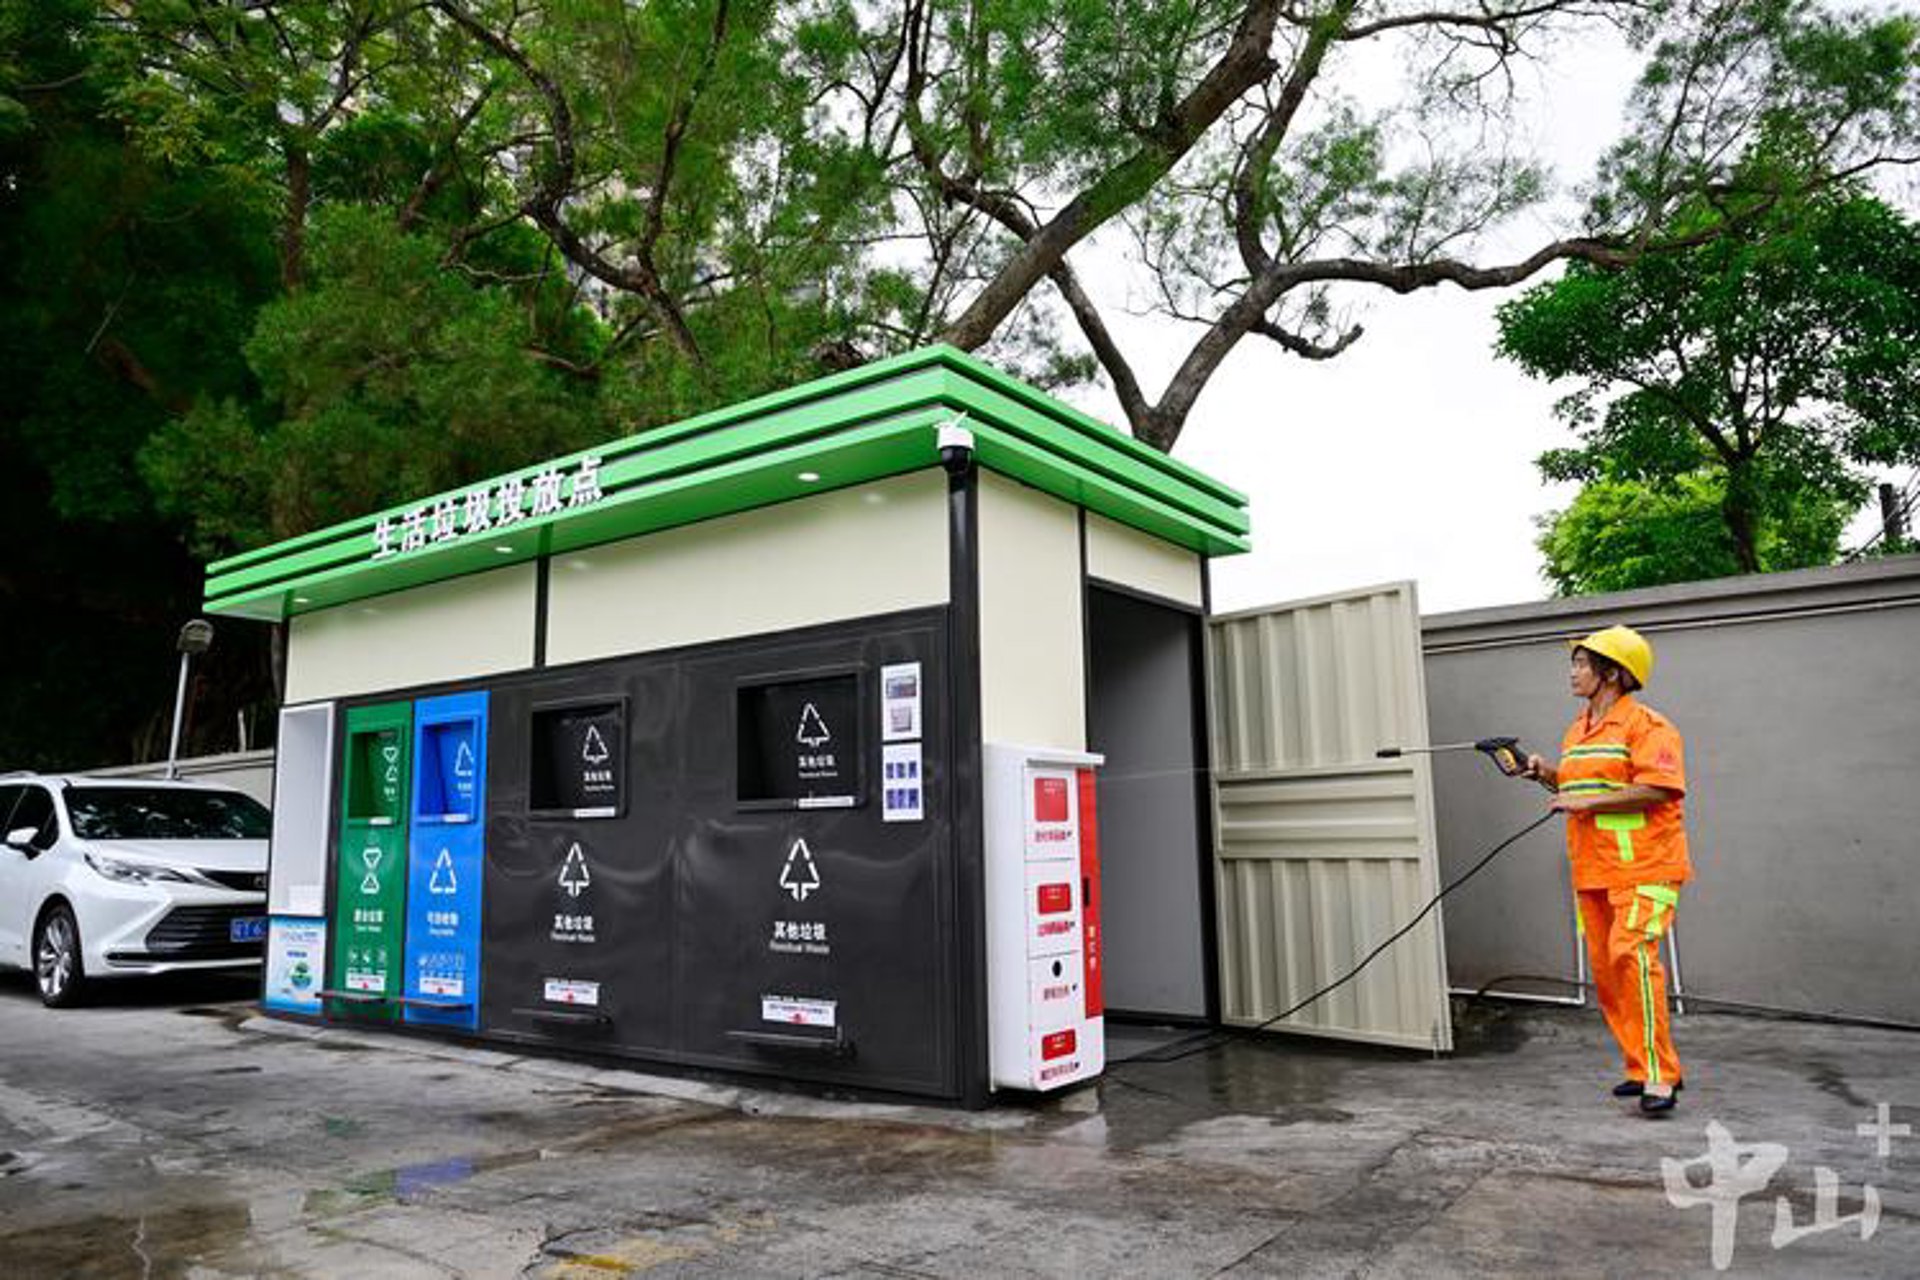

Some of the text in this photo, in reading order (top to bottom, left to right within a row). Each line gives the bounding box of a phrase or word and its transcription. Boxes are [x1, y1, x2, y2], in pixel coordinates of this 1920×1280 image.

[372, 455, 603, 559] 生活垃圾投放点
[554, 914, 594, 931] 其他垃圾
[774, 920, 827, 940] 其他垃圾
